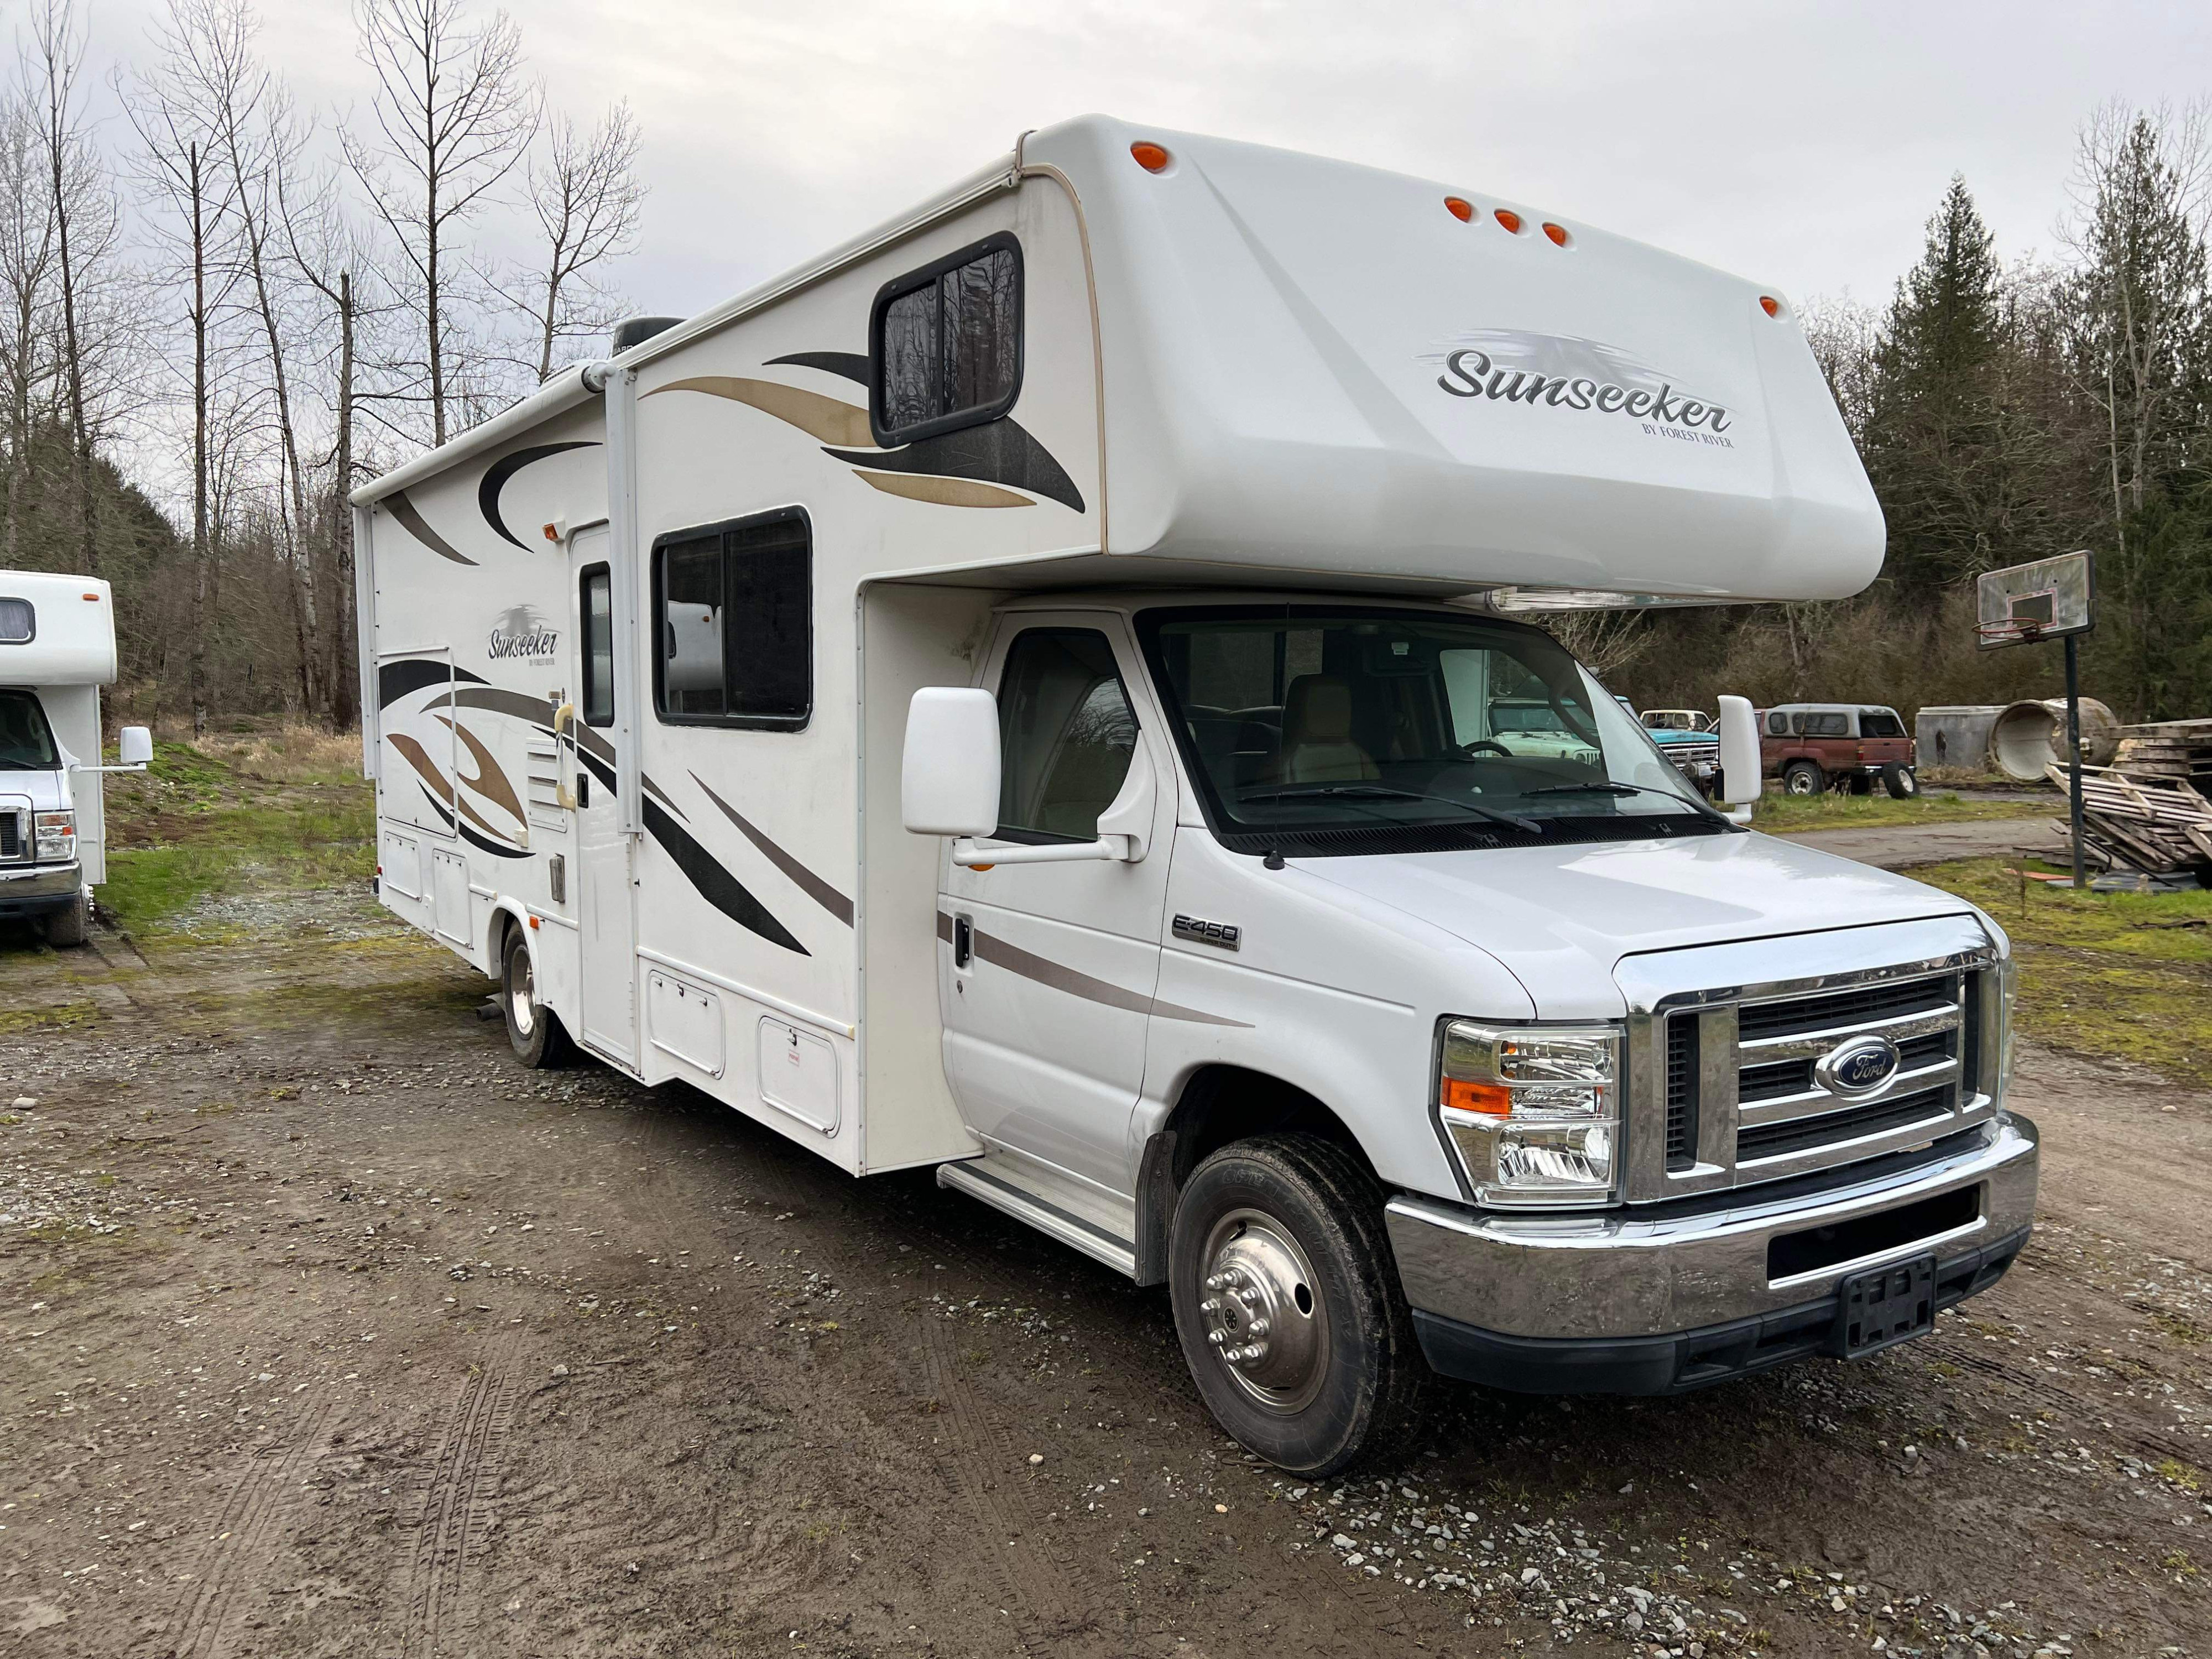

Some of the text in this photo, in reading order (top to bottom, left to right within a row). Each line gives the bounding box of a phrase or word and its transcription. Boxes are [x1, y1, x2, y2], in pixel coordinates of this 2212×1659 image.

[1437, 349, 1731, 433] Sunseeker
[1641, 423, 1735, 448] BY FOREST RIVER
[488, 624, 557, 659] Sunseeker
[1852, 1053, 1887, 1080] Ford
